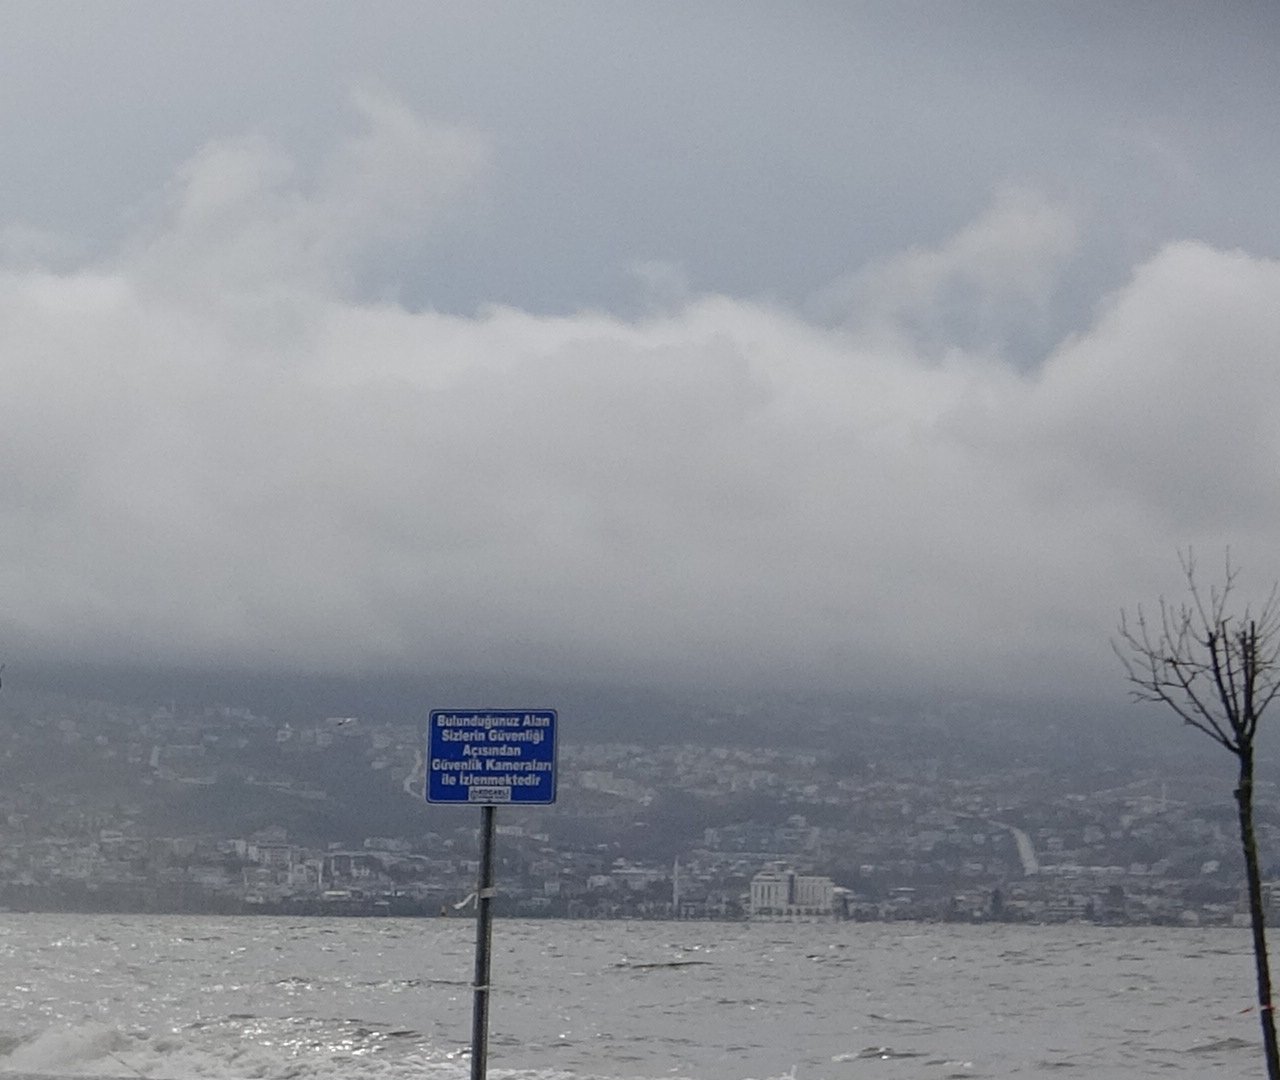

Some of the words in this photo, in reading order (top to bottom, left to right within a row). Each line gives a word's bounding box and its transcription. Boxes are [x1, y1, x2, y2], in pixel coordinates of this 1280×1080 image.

[437, 715, 520, 729] Bulunduğunuz
[523, 715, 550, 727] Alan
[442, 730, 485, 742] Sizlerin
[488, 730, 544, 744] Güvenliği
[462, 744, 521, 758] Açısından
[432, 759, 482, 771] Güvenlik
[485, 759, 551, 771] Kameraları
[441, 774, 456, 786] ile
[459, 772, 541, 787] İzlenmektedir
